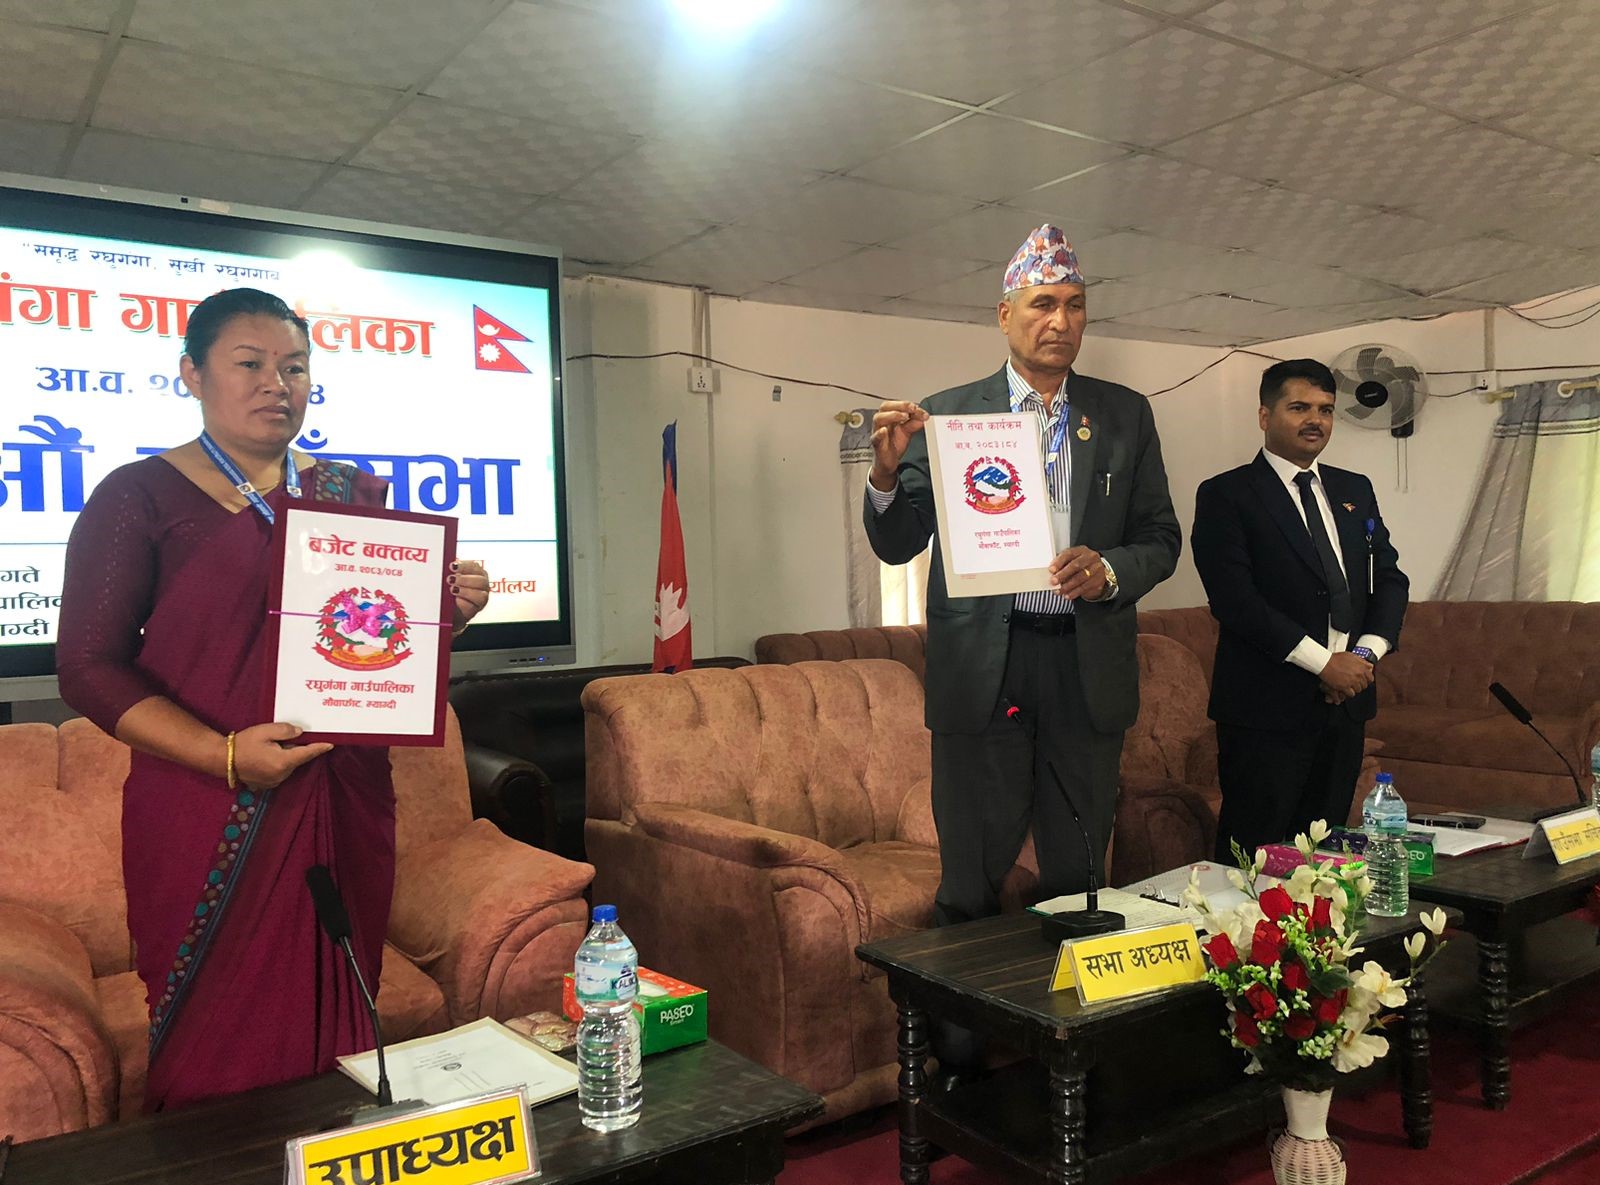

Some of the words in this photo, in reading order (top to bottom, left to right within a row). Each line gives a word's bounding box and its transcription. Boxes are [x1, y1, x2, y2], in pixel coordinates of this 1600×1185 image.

[36, 366, 133, 394] आ.व.
[967, 422, 984, 431] तथा
[309, 534, 357, 556] बजेट
[363, 542, 430, 563] बक्तव्य
[1081, 951, 1125, 979] सभा
[1128, 939, 1192, 969] अध्यक्ष
[660, 1004, 694, 1023] PASEO
